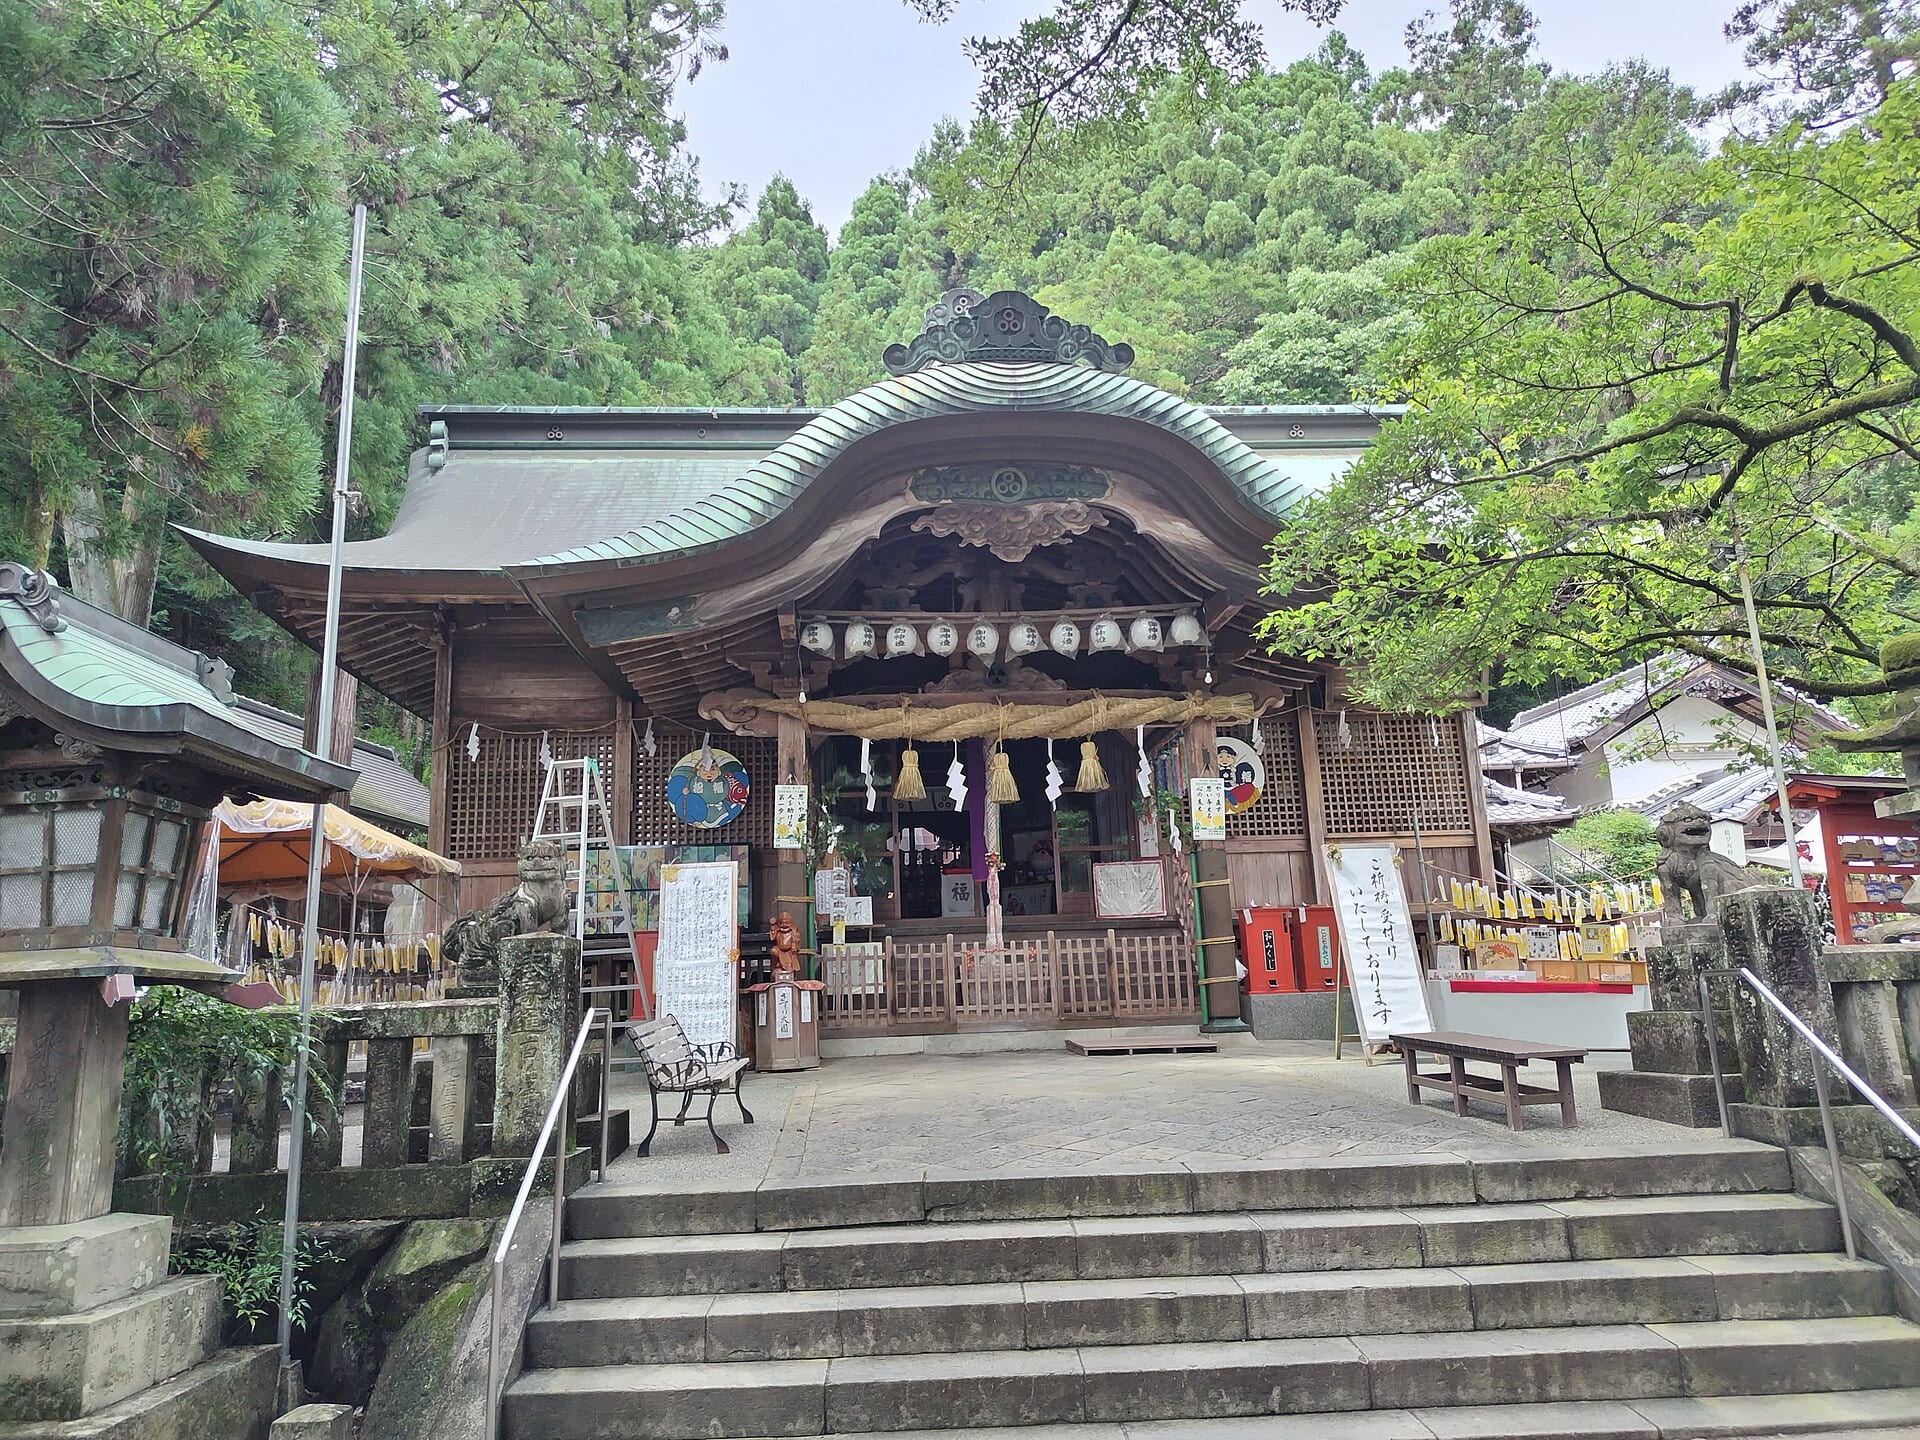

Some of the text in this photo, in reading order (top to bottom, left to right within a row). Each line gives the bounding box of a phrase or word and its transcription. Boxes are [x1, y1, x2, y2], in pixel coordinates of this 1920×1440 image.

[951, 881, 971, 902] 福
[1264, 931, 1275, 970] おみくじ
[1350, 886, 1392, 1025] いたしております
